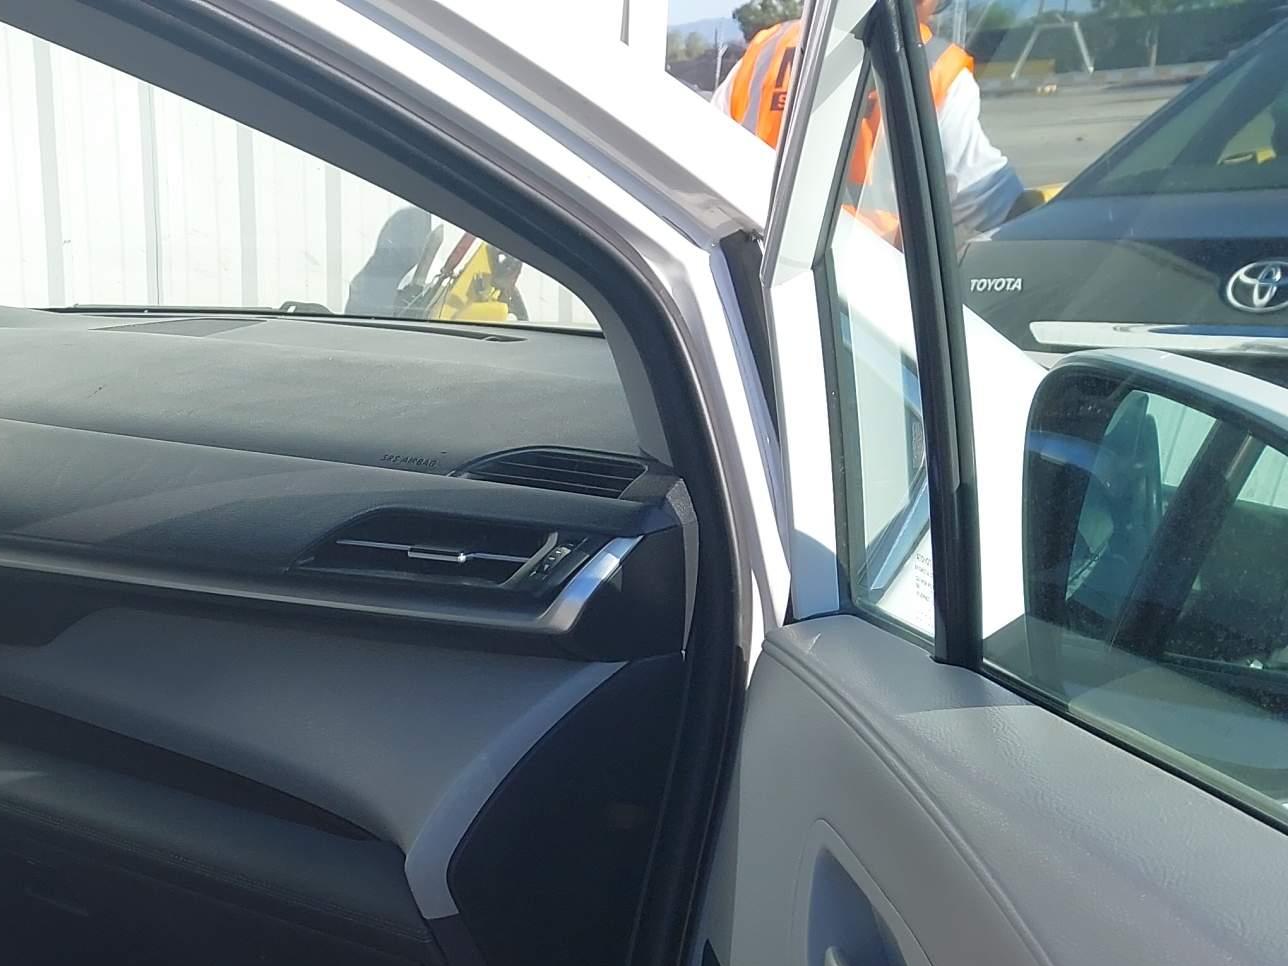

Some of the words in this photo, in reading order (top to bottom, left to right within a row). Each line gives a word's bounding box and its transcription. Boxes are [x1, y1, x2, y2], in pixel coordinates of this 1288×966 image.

[970, 278, 1023, 292] TOYOTA
[381, 454, 401, 463] SRS
[402, 456, 439, 468] AIRBAG
